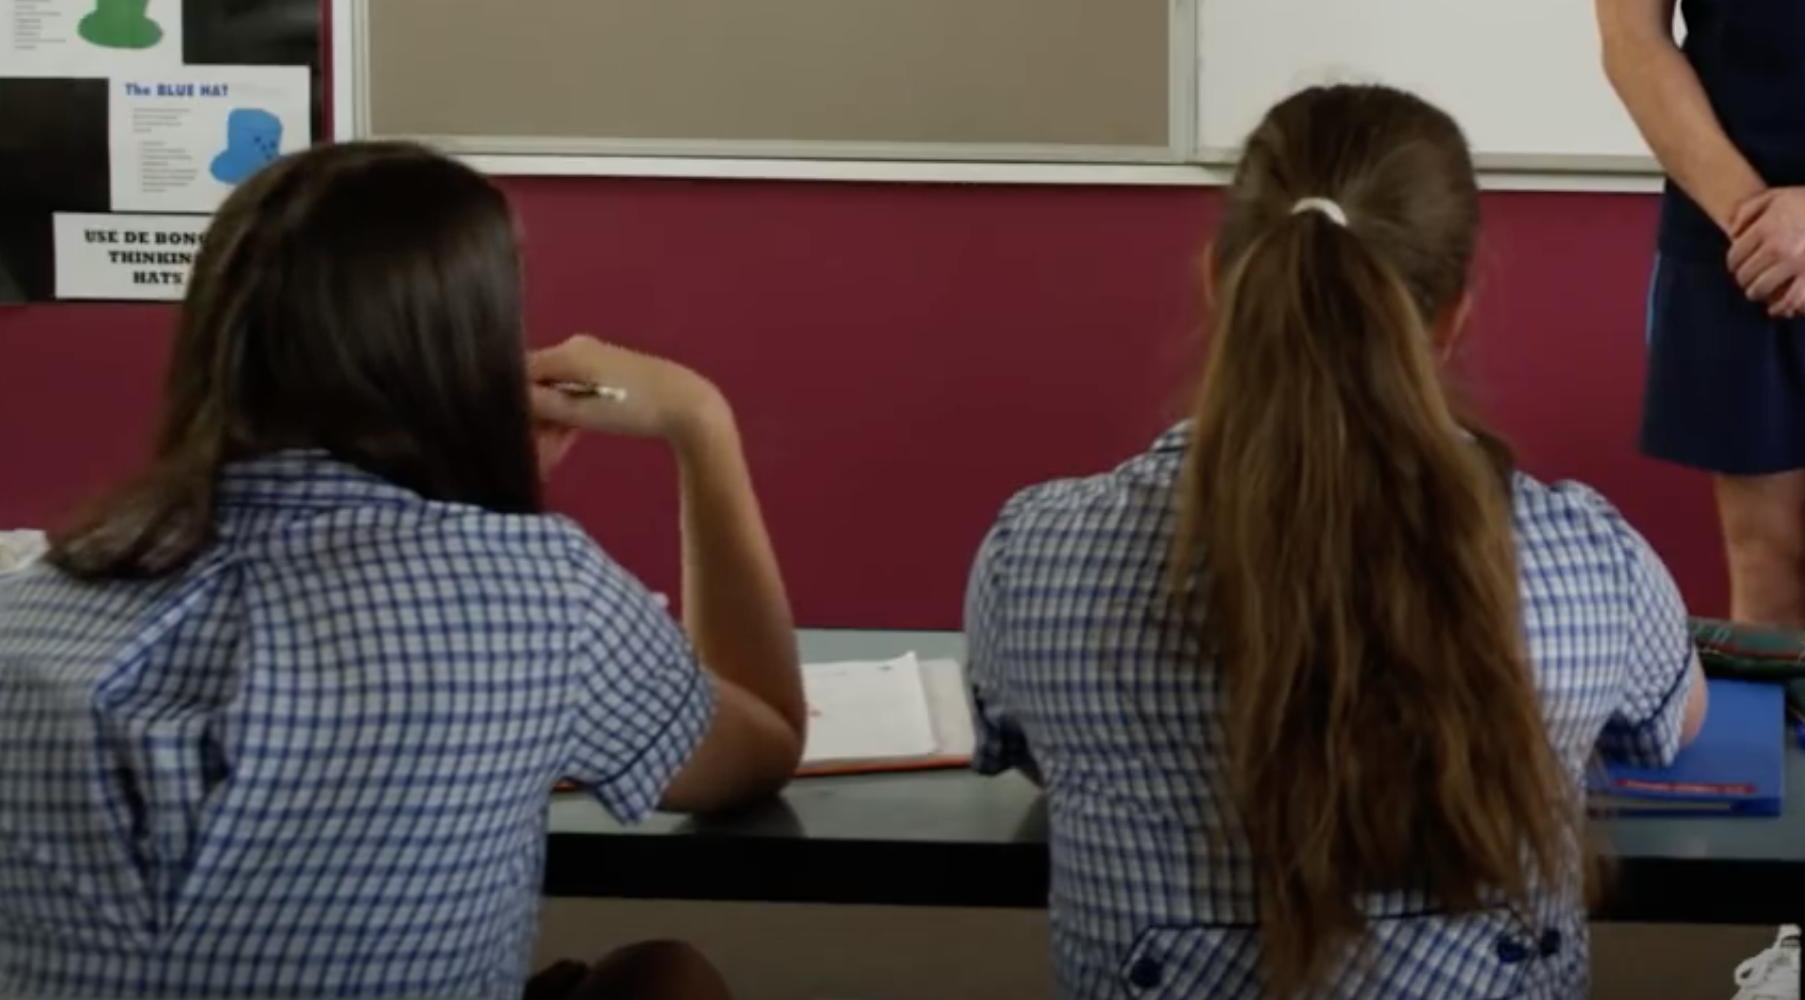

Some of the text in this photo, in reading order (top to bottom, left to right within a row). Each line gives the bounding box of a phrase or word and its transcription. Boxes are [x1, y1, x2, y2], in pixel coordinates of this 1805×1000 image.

[125, 82, 229, 98] The BLUE HAT
[84, 229, 119, 244] USE
[124, 230, 150, 244] DE
[133, 270, 183, 285] HATS
